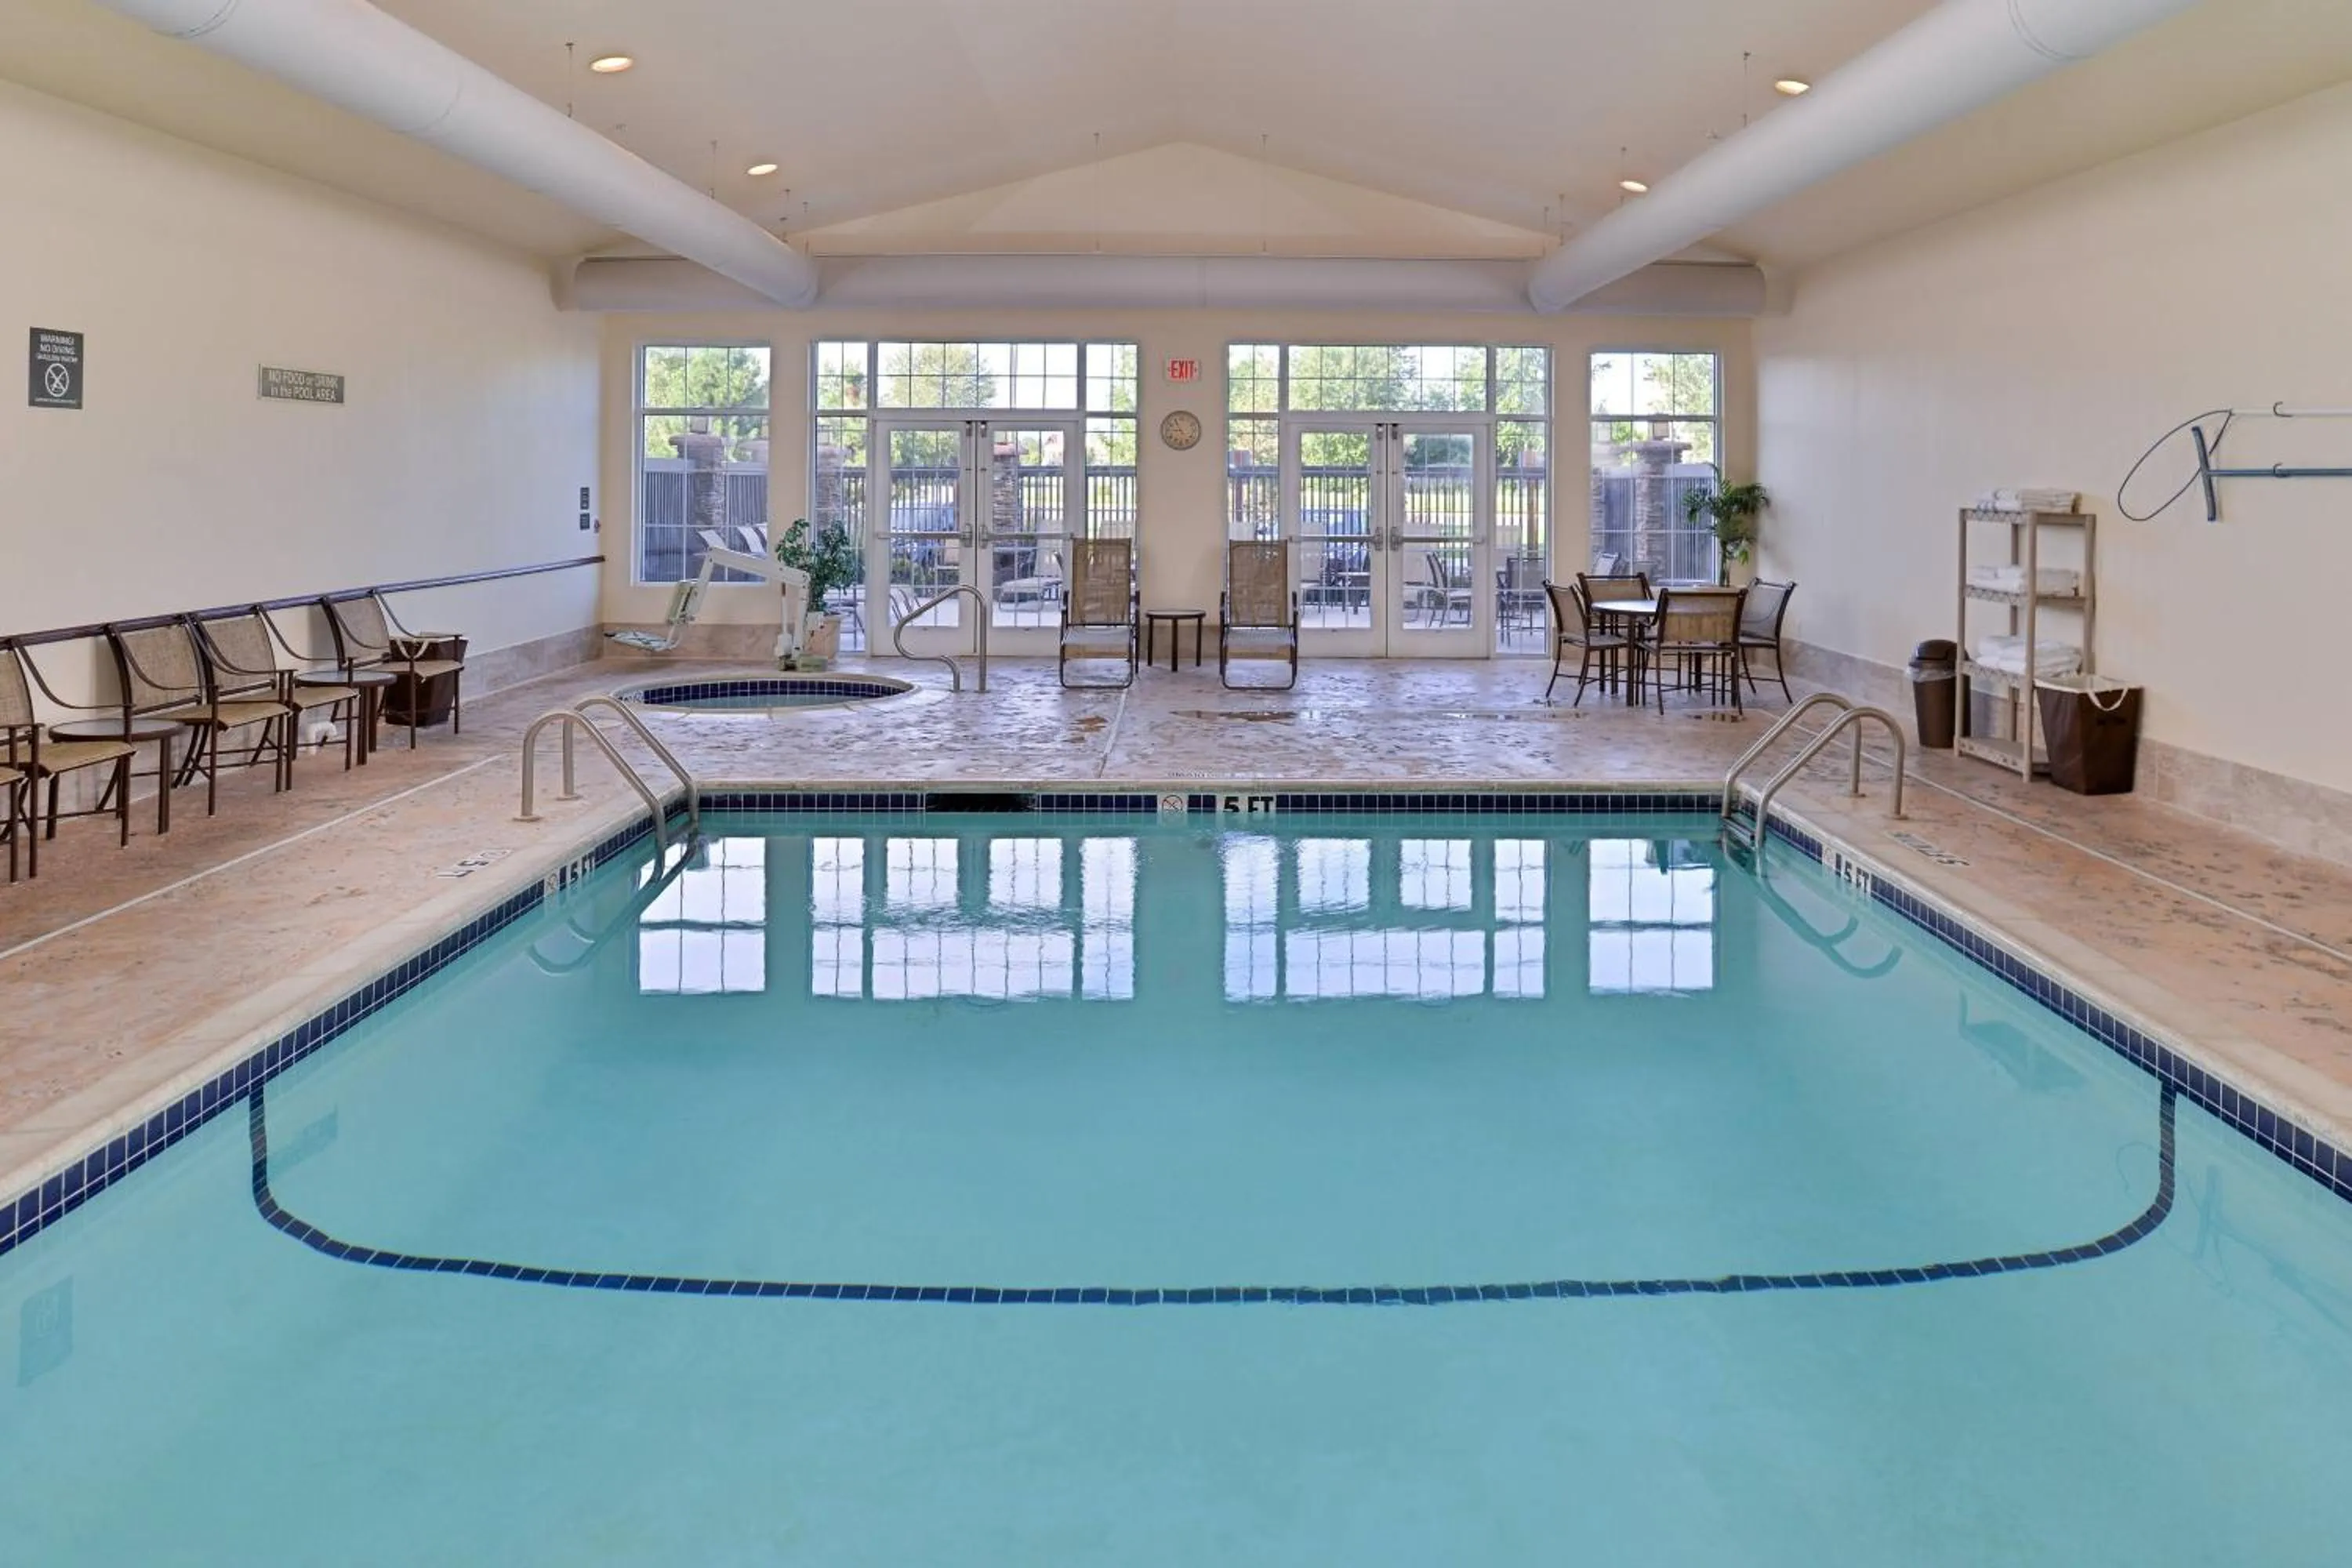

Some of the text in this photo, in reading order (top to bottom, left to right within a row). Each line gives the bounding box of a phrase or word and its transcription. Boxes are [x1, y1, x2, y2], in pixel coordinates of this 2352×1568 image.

[39, 343, 51, 352] NO
[1171, 360, 1195, 379] EXIT
[269, 369, 282, 383] NO
[283, 372, 305, 386] FOOD
[314, 375, 338, 390] DRINK
[280, 385, 292, 397] the
[293, 387, 314, 400] POOL
[315, 388, 336, 402] AREA
[1223, 796, 1273, 813] 5 FT
[570, 855, 595, 883] 5 FT
[1845, 860, 1870, 892] 5 FT
